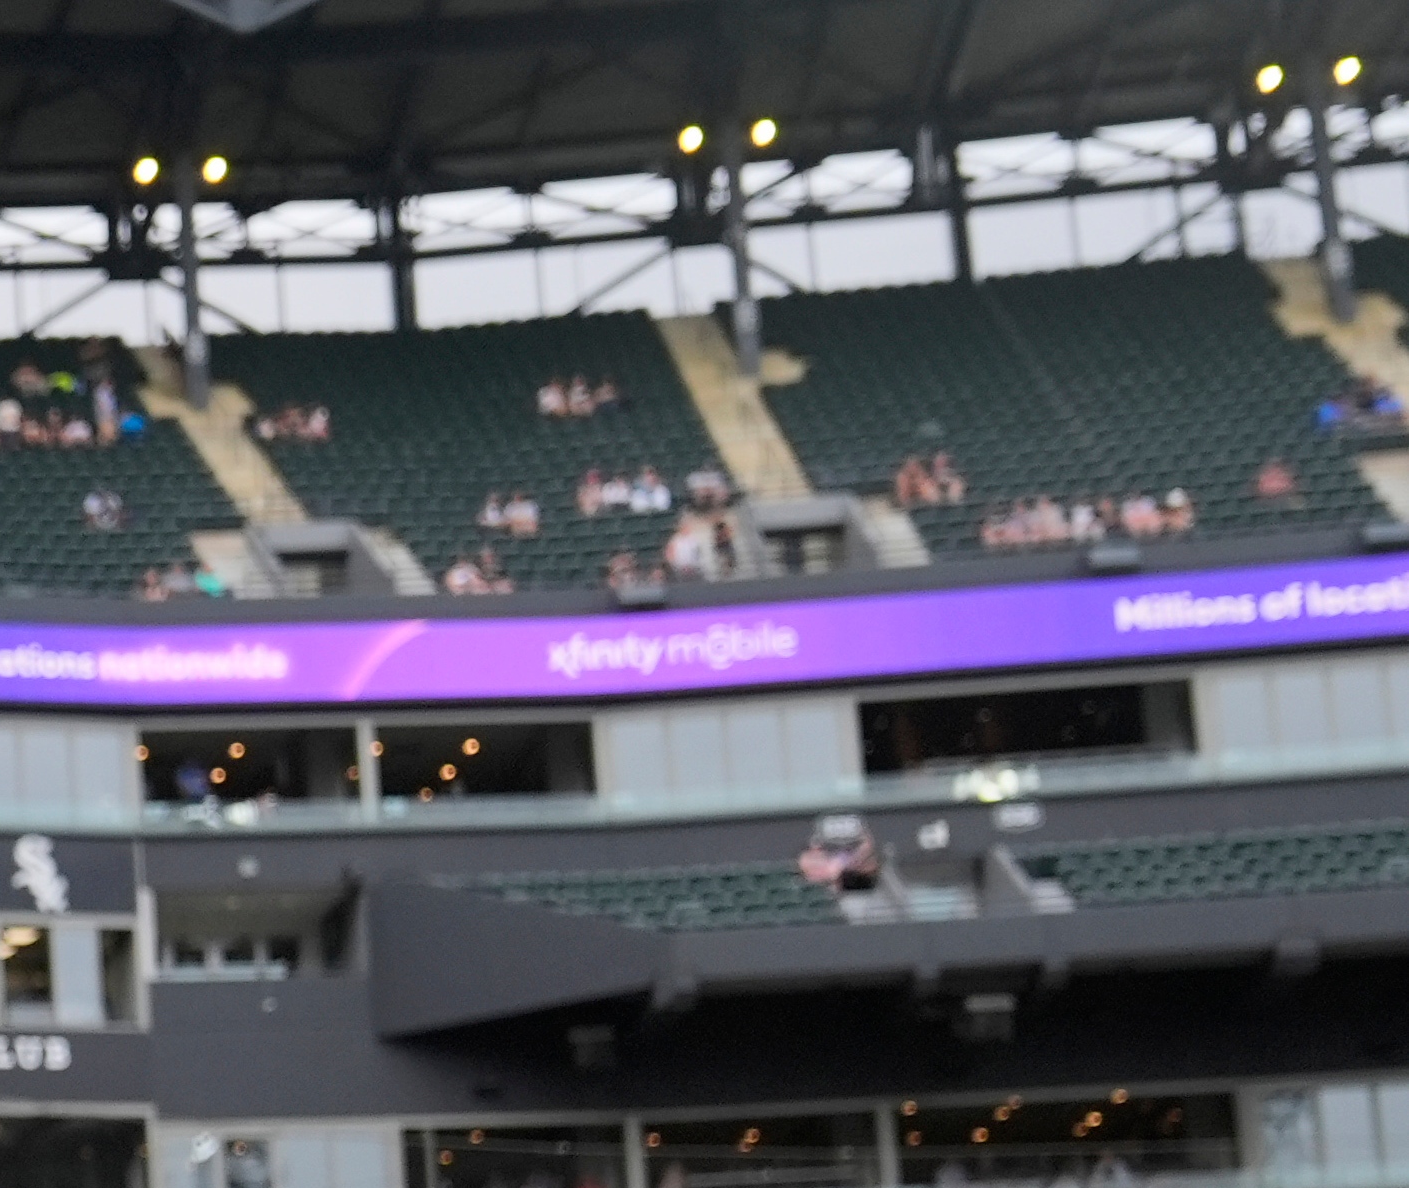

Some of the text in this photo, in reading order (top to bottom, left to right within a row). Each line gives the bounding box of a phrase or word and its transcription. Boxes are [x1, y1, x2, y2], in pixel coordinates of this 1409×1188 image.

[1113, 590, 1257, 633] Millions
[1259, 581, 1303, 622] of
[97, 642, 289, 682] nationwide
[548, 620, 799, 679] xfinity mobile
